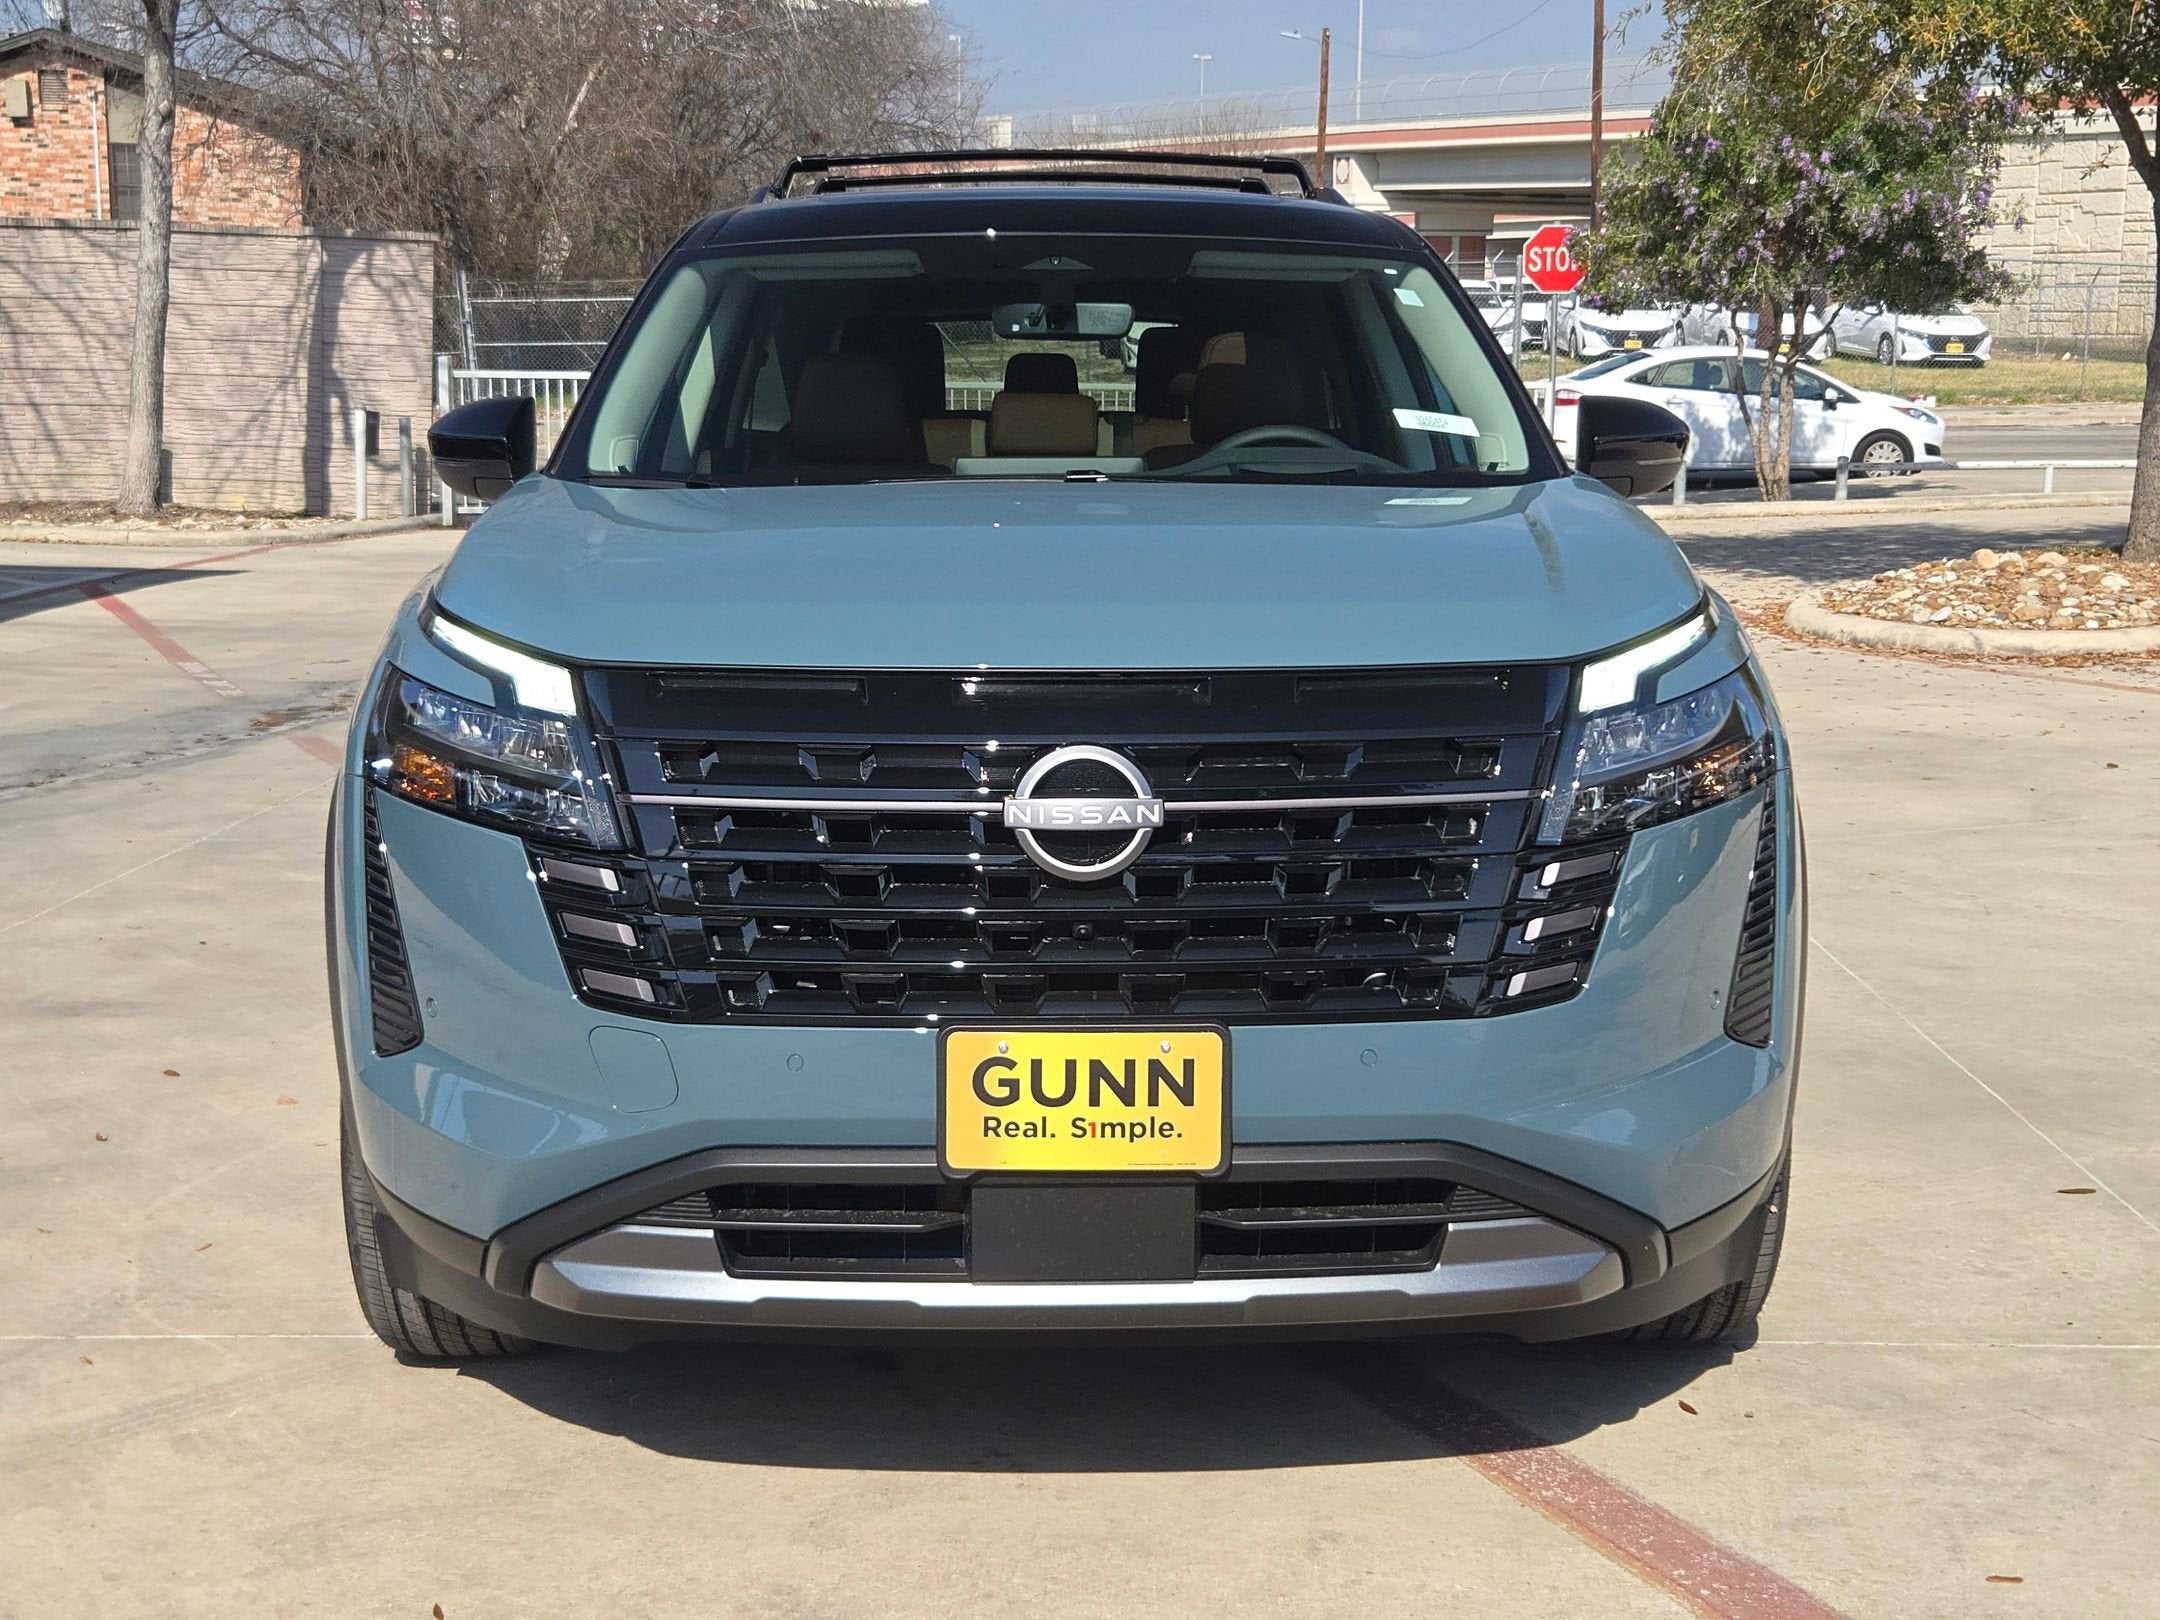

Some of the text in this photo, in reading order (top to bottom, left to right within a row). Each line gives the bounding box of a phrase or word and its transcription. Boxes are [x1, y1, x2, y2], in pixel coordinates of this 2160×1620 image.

[1008, 804, 1160, 825] NISSAN
[972, 1056, 1195, 1108] GUNN
[983, 1116, 1056, 1139] Real.
